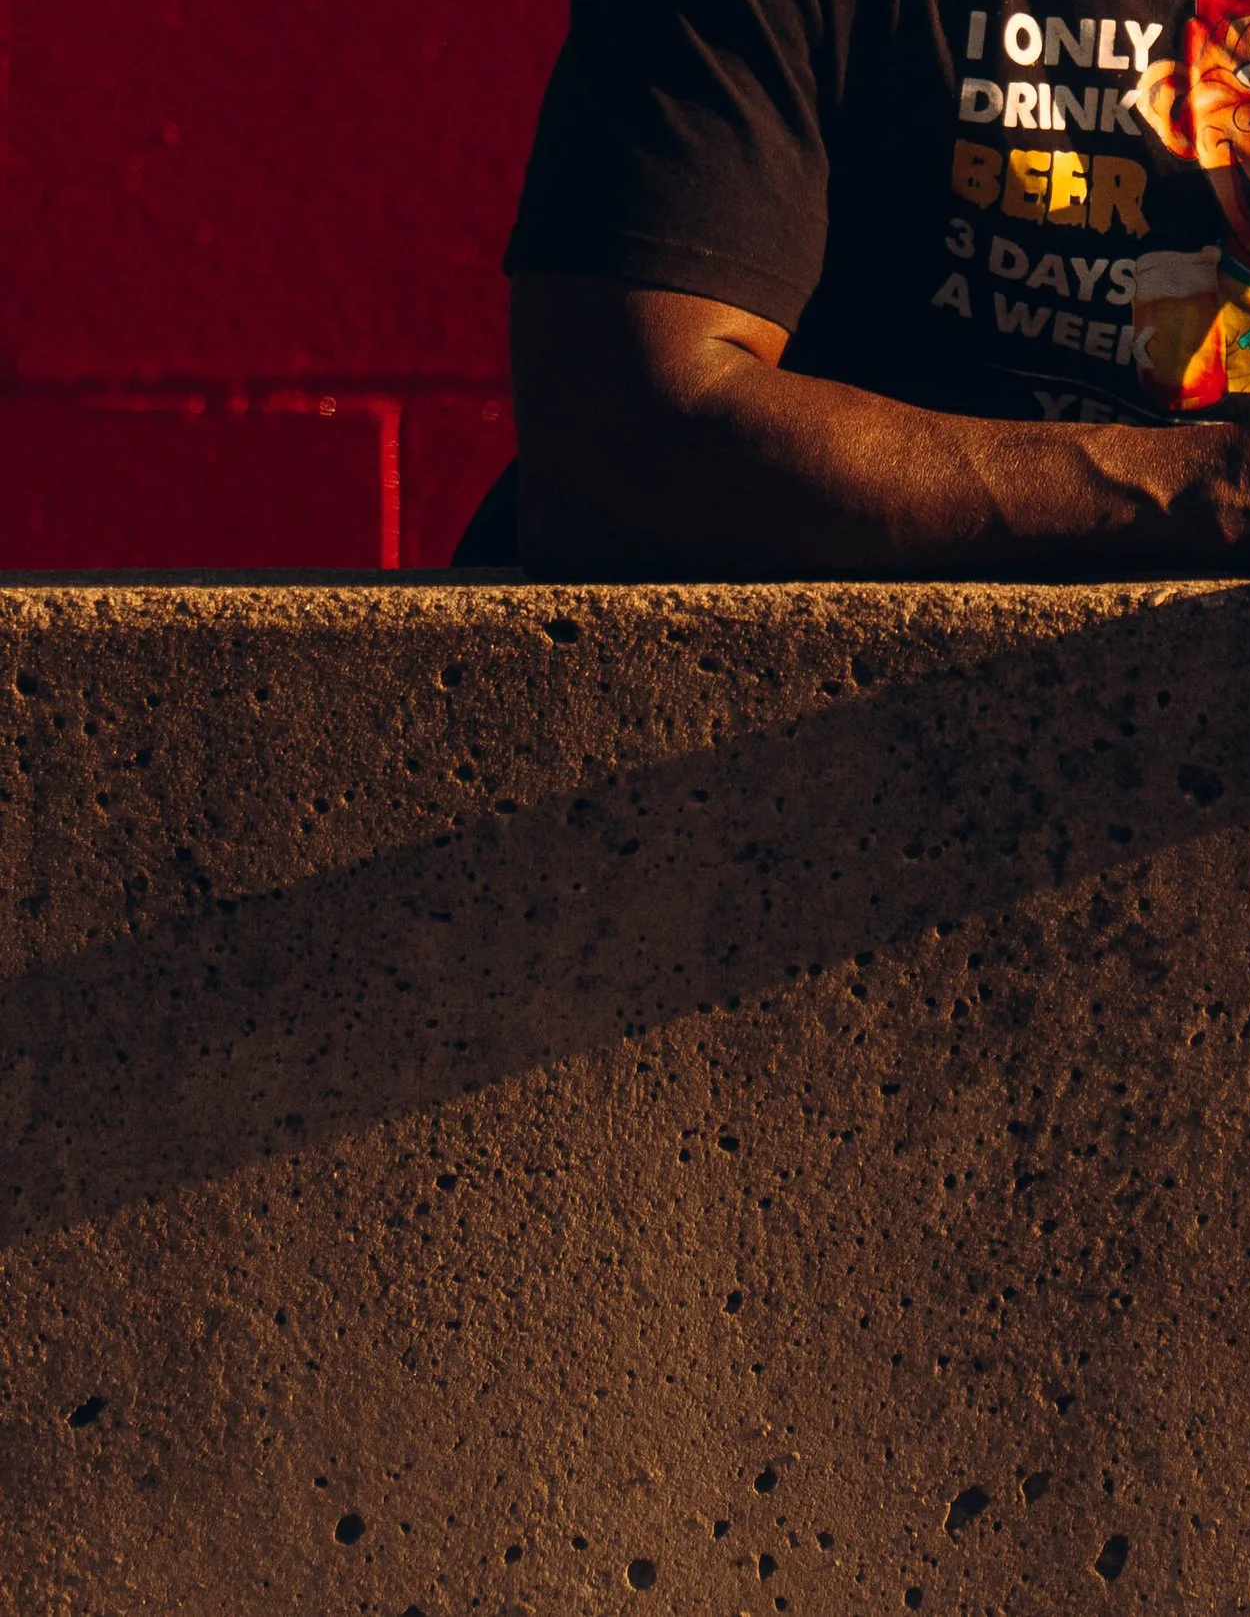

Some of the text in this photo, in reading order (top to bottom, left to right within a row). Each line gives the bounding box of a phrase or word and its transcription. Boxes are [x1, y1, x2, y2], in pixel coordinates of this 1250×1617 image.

[966, 10, 1163, 74] I ONLY
[959, 77, 1145, 136] DRINK
[951, 138, 1152, 241] BEER
[944, 217, 1138, 307] 3 DAYS
[930, 271, 1157, 369] A WEEK
